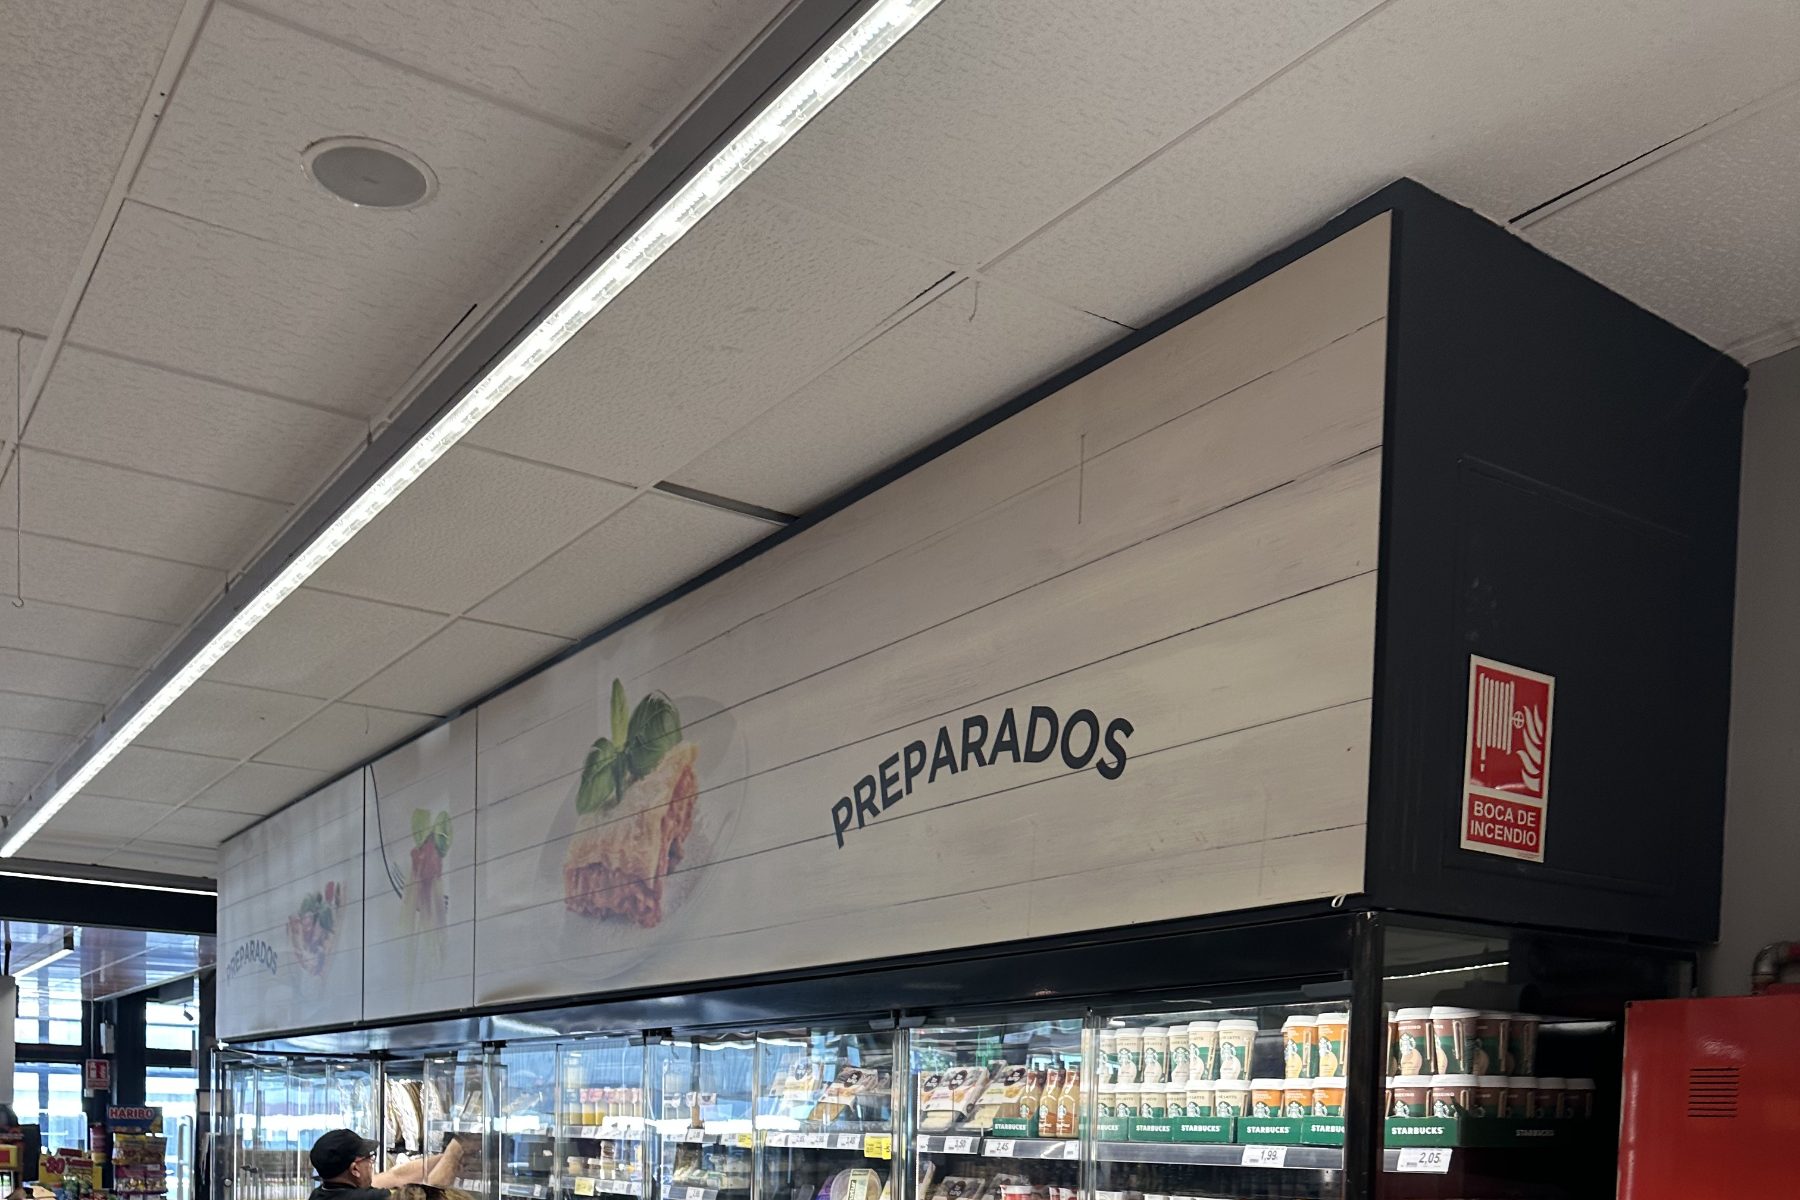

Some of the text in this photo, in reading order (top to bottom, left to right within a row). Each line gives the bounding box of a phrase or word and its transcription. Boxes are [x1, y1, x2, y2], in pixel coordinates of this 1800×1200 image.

[831, 705, 1134, 850] PREPARADOS
[1473, 801, 1536, 827] BOCA DE
[1470, 820, 1537, 846] INCENDIO
[108, 1106, 154, 1120] HARIBO
[994, 1123, 1027, 1131] STARBUCKS
[1136, 1125, 1171, 1133] STARBUCKS
[1181, 1124, 1221, 1132] STARBUCKS
[1246, 1126, 1290, 1134] STARBUCKS
[1391, 1126, 1443, 1135] STARBUCKS
[1260, 1150, 1278, 1161] 1,99
[1418, 1152, 1441, 1165] 2,05
